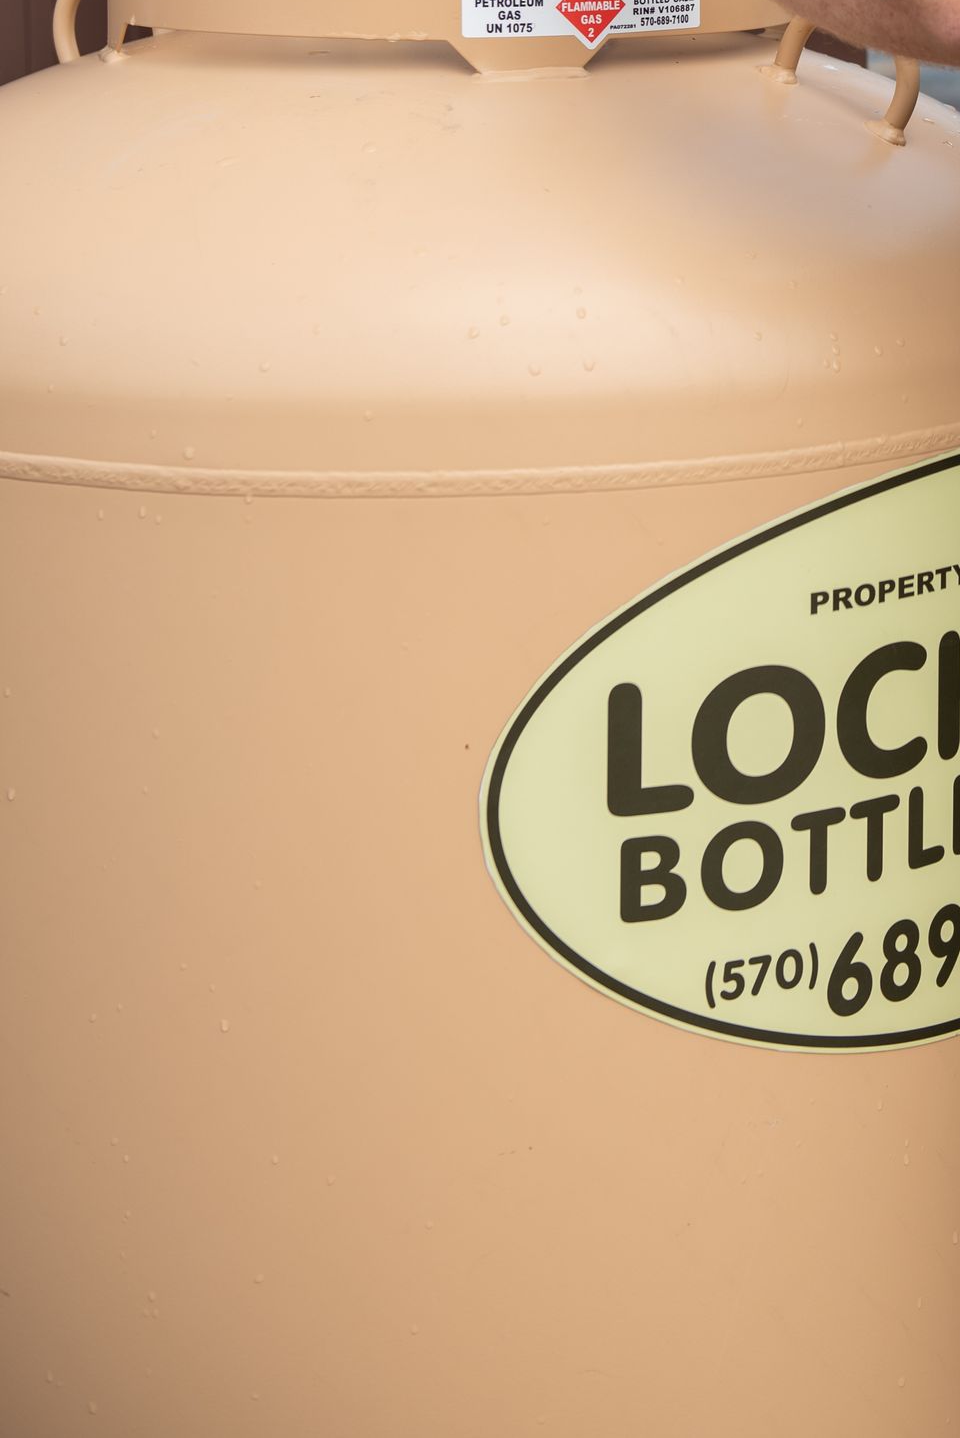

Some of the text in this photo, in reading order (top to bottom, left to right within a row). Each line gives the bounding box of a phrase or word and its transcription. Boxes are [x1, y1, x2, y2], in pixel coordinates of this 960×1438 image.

[561, 0, 620, 12] FLAMMABLE
[632, 4, 695, 16] RIN# V106887
[498, 10, 522, 20] GAS
[580, 14, 602, 25] GAS
[640, 14, 689, 27] 570-689-7100
[486, 23, 533, 34] UN 1075
[587, 27, 595, 38] 2
[704, 942, 820, 1009] (570)
